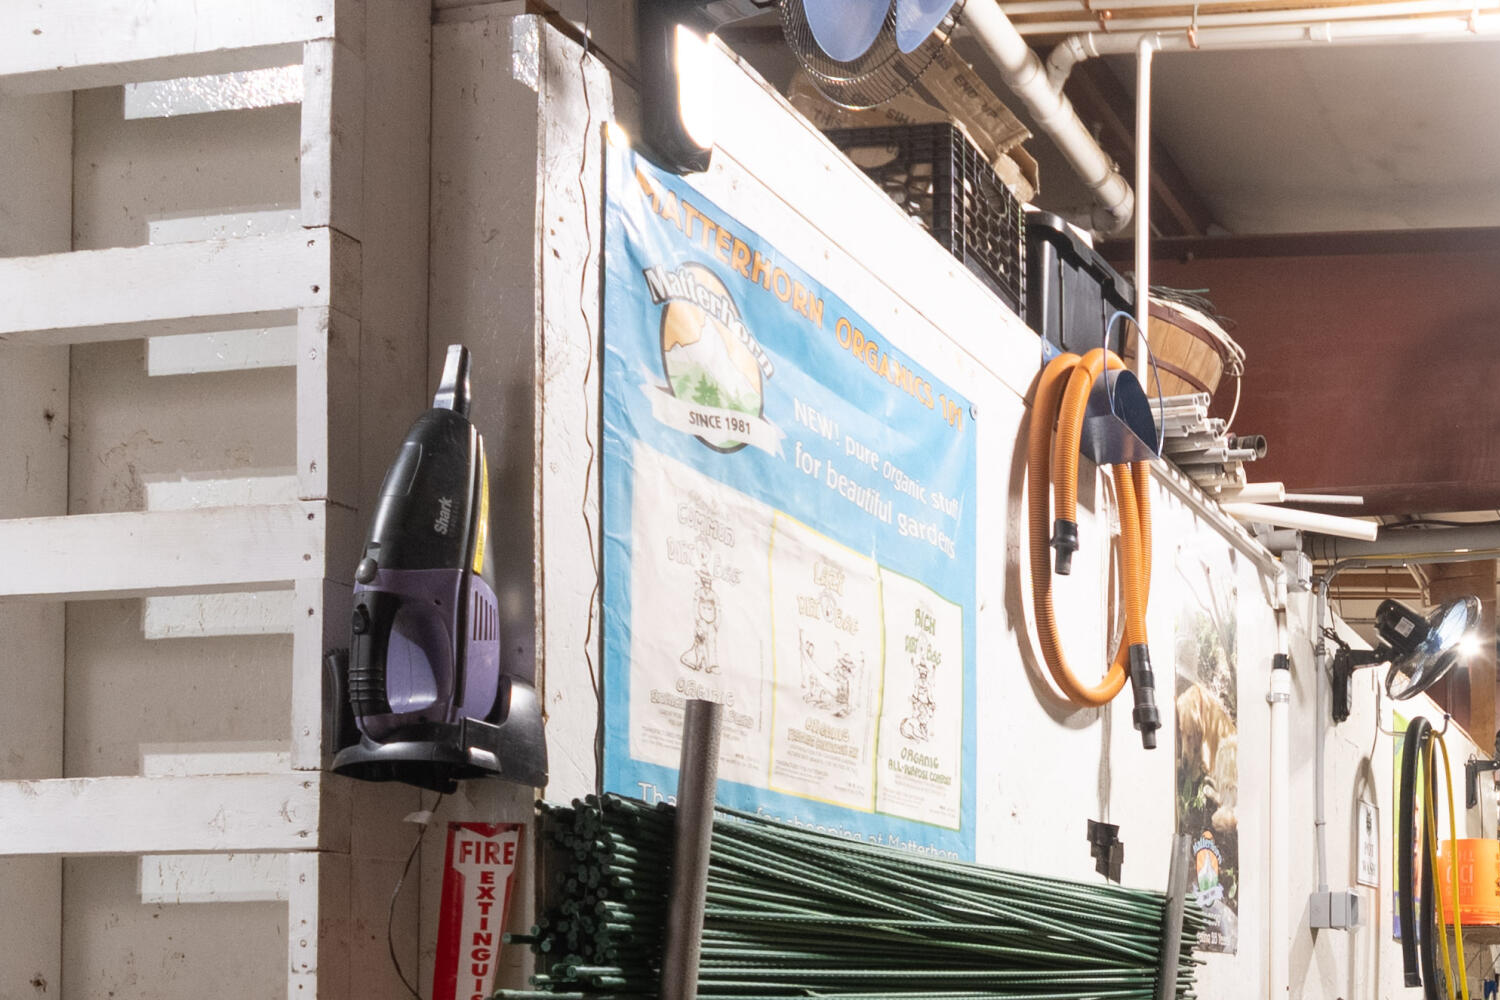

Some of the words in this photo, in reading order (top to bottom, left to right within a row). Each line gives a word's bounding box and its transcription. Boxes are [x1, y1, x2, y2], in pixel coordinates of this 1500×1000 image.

[643, 264, 775, 381] Matterhorn
[835, 316, 935, 410] ORGANICS
[938, 393, 963, 433] 101
[688, 410, 722, 431] SINCE
[724, 415, 752, 434] 1981
[793, 396, 841, 446] NEW!
[844, 434, 880, 472] pure
[882, 460, 927, 504] organic
[929, 491, 959, 520] stuff
[433, 496, 453, 536] Shark
[795, 440, 823, 479] for
[826, 459, 893, 525] beautiful
[897, 512, 956, 560] gardens
[900, 746, 941, 770] ORGANIC
[458, 840, 515, 866] FIRE
